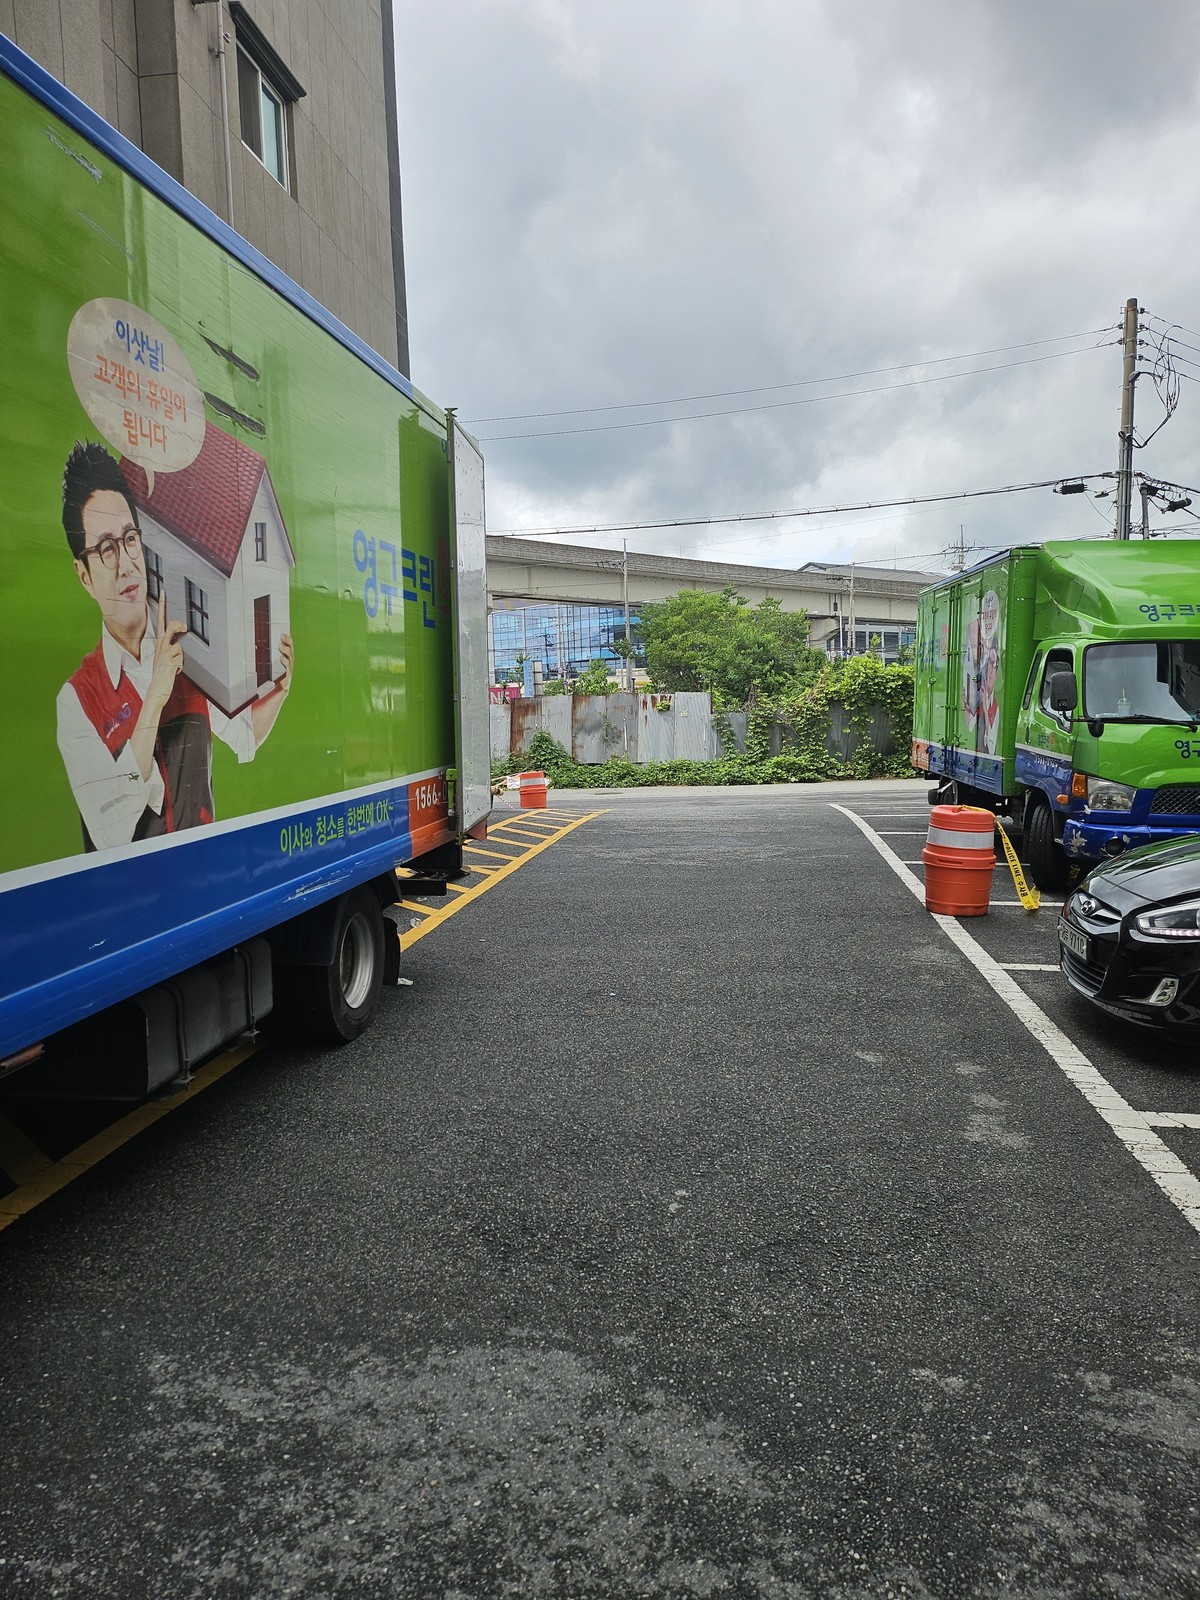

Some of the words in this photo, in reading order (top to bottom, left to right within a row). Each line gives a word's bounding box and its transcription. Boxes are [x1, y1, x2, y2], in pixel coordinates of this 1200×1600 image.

[115, 319, 165, 372] 이삿날!
[94, 354, 141, 401] 고객의
[146, 378, 187, 422] 휴일이
[123, 410, 167, 453] 됩니다
[353, 529, 436, 629] 영구크린
[1139, 604, 1200, 622] 영구크
[280, 822, 313, 856] 이사와
[316, 815, 345, 846] 청소를
[347, 801, 374, 835] 한번에
[1005, 842, 1016, 863] POLICE
